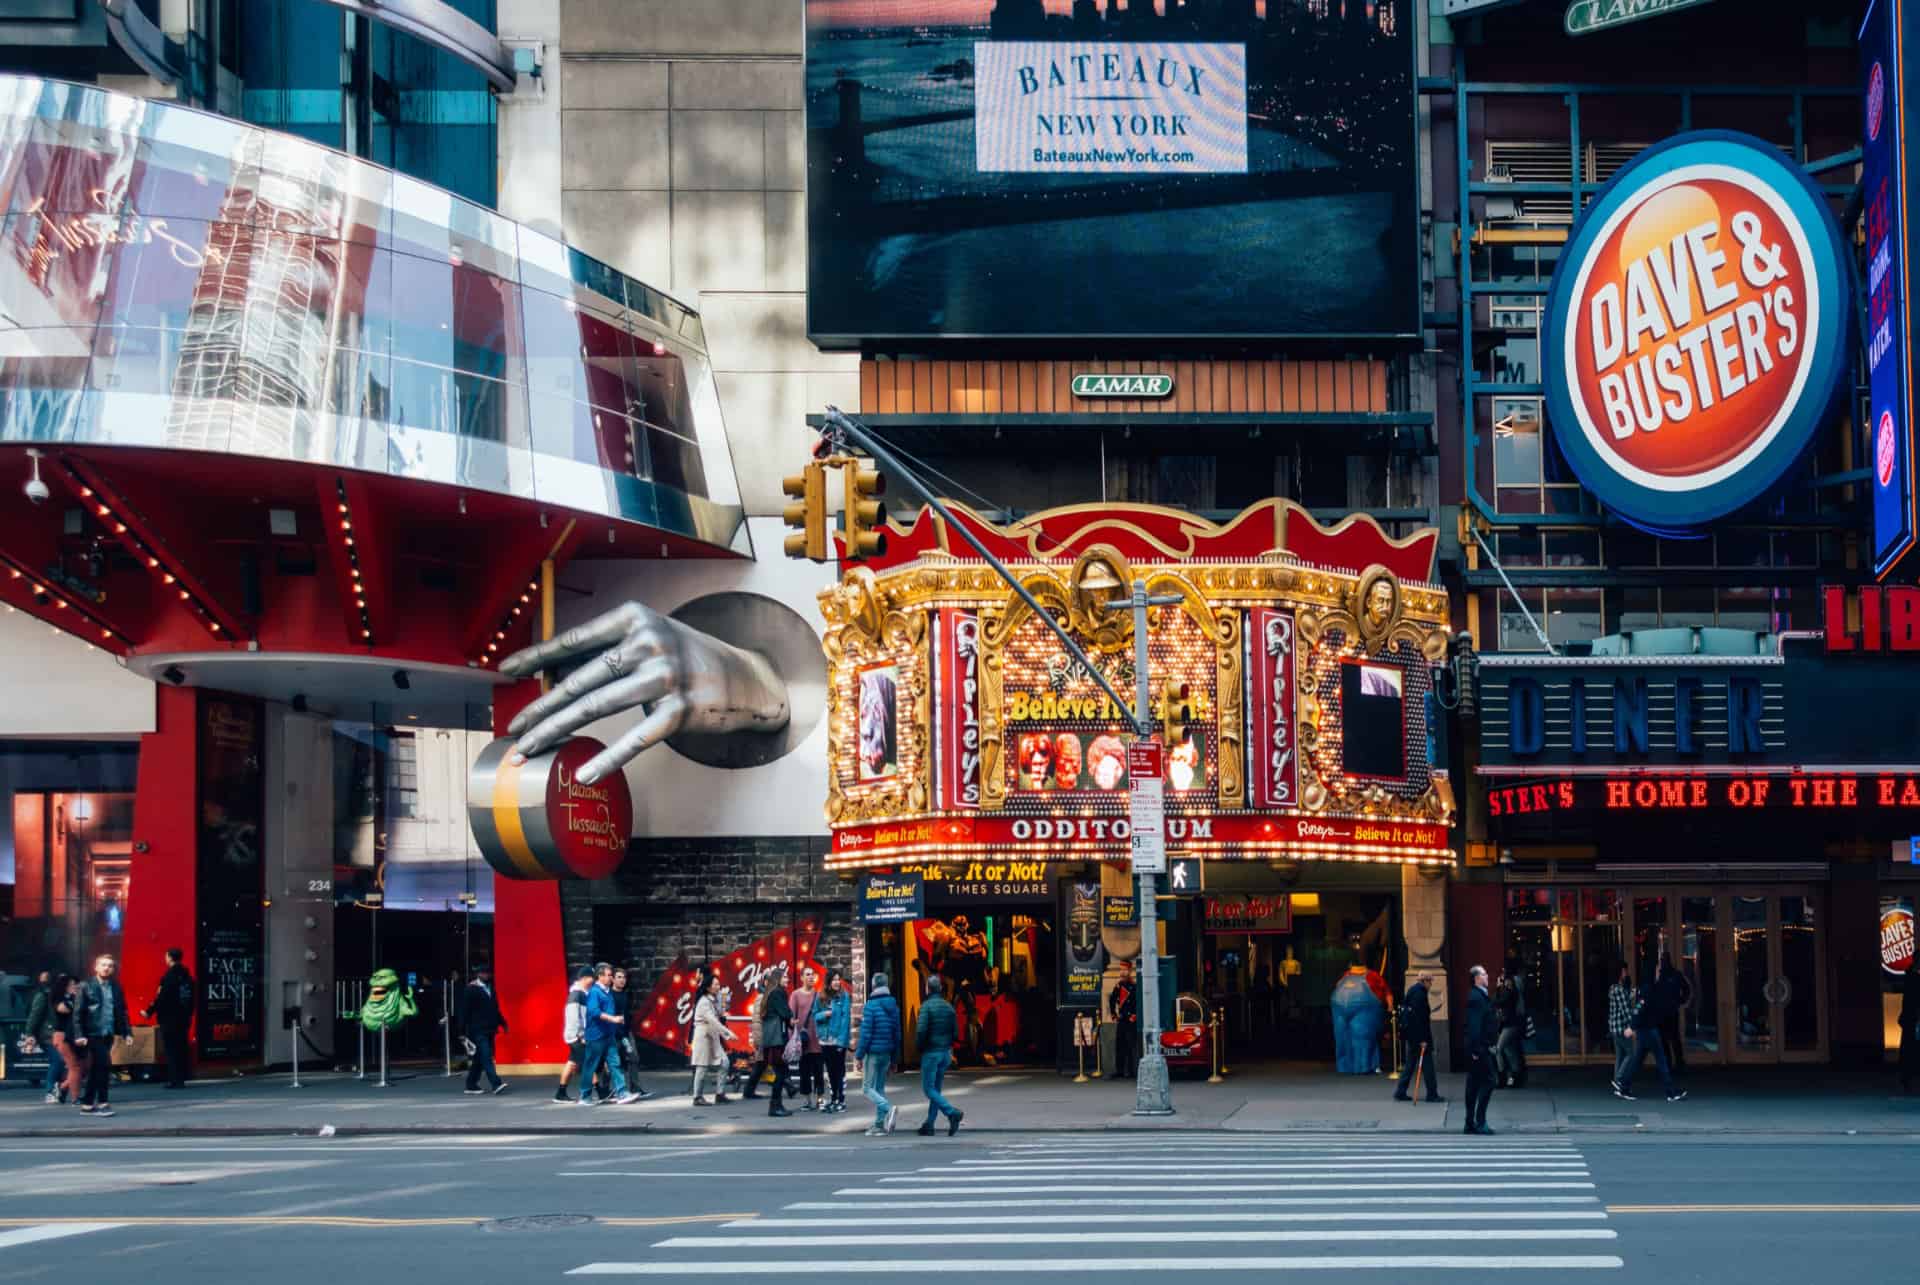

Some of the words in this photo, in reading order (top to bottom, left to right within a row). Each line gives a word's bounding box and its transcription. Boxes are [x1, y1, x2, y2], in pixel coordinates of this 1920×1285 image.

[1589, 0, 1686, 24] LAM
[1017, 54, 1204, 96] BATEAUX
[1037, 114, 1100, 136] NEW
[1112, 114, 1187, 136] YORK
[1033, 148, 1194, 163] BateauxNewYork.com
[1592, 220, 1738, 373] DAVE
[1731, 210, 1789, 288] &
[1599, 285, 1798, 440] BUSTER'S
[1080, 378, 1162, 393] LAMAR
[1011, 691, 1098, 721] Believe
[1508, 677, 1761, 753] DINER
[1488, 781, 1574, 816] STER'S
[1606, 780, 1708, 808] HOME
[1728, 779, 1769, 807] OF
[1790, 779, 1858, 807] THE
[1012, 819, 1213, 840] ODDITOUM
[1354, 824, 1390, 842] Believe
[1392, 827, 1402, 842] It
[1402, 832, 1414, 843] or
[1415, 829, 1436, 845] Not!
[966, 863, 983, 881] It
[985, 866, 1003, 881] or
[1006, 863, 1047, 881] Not!
[309, 880, 330, 891] 234
[948, 884, 987, 895] TIMES
[994, 884, 1048, 895] SQUARE
[208, 957, 254, 974] FACE
